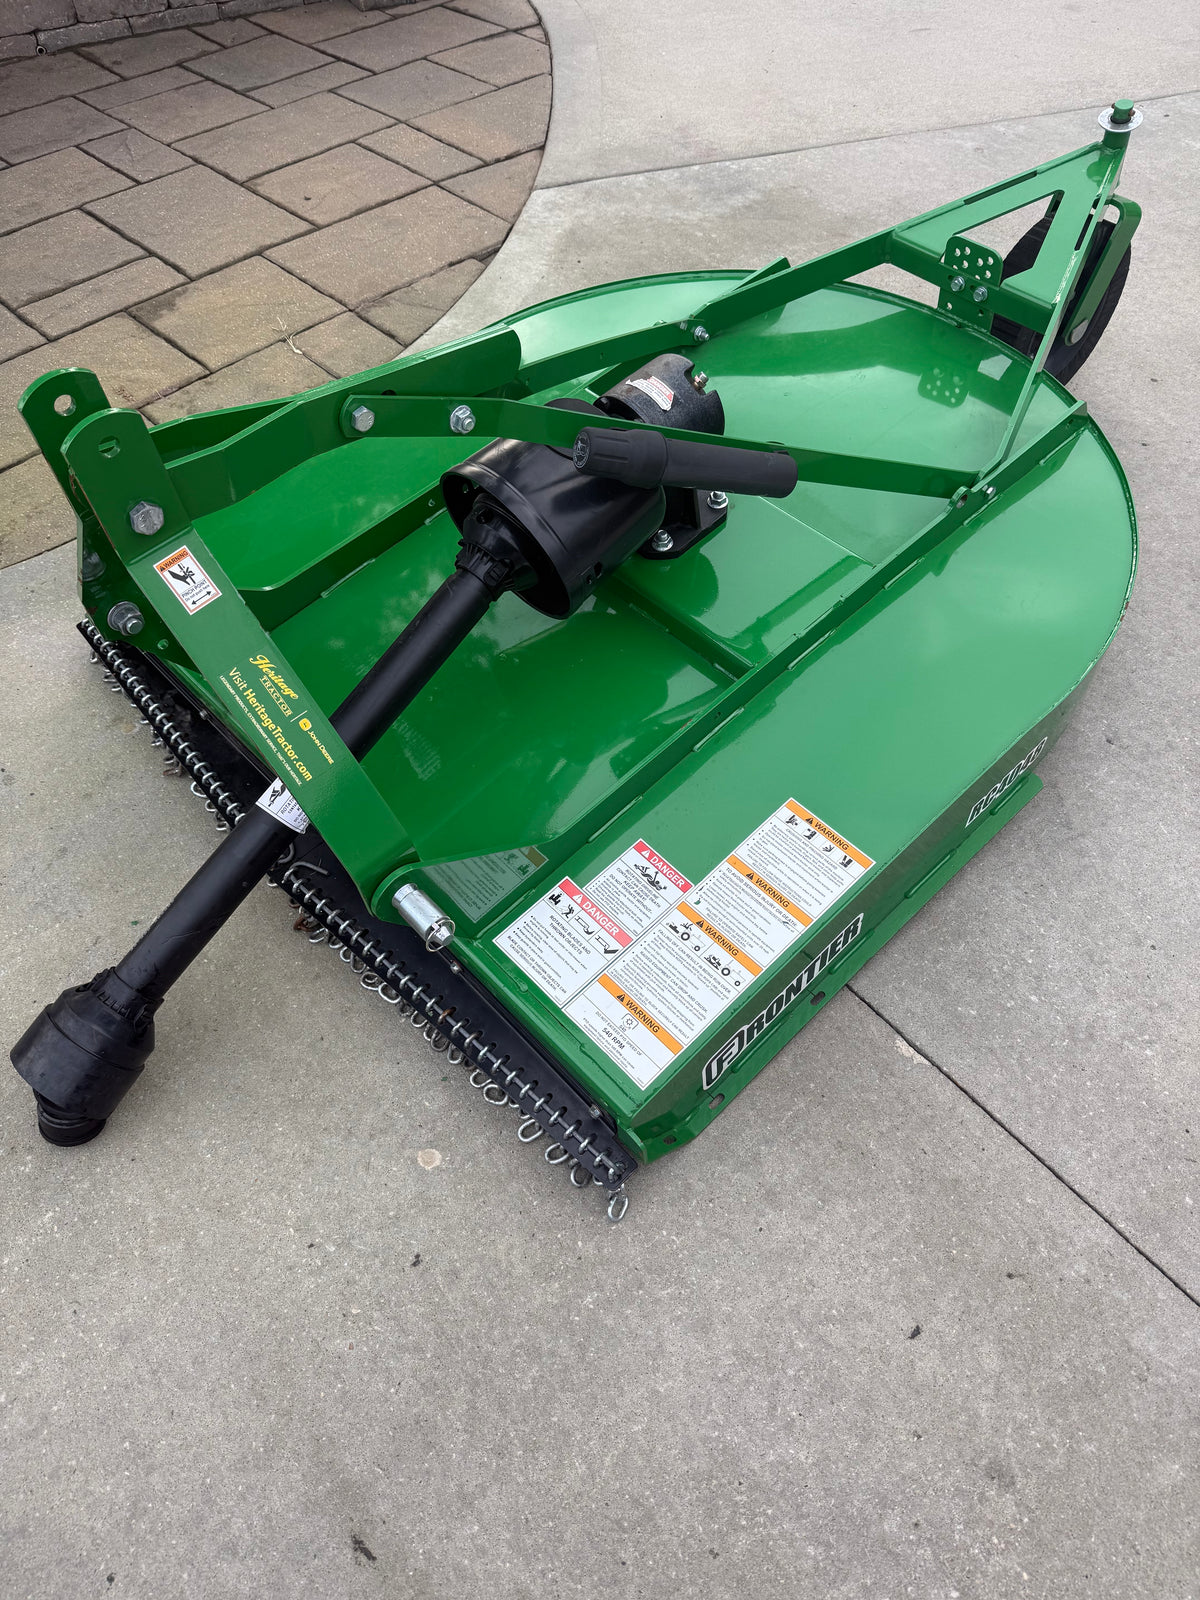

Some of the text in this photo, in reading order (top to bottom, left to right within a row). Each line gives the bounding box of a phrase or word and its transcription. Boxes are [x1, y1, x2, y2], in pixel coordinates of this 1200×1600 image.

[163, 550, 188, 568] WARNING
[181, 579, 206, 597] PINCH POINT
[249, 654, 298, 700] Heritage
[260, 675, 293, 717] TRACTOR
[229, 667, 313, 782] Visit HeritageTractor.com
[308, 730, 334, 765] JOHN DEERE
[813, 822, 849, 850] WARNING
[649, 855, 685, 887] DANGER
[730, 871, 744, 883] AVOID
[742, 881, 761, 897] SERIOUS
[760, 896, 776, 909] INJURY
[754, 877, 790, 908] WARNING
[548, 914, 568, 933] ROTATING
[566, 931, 583, 947] BLADES
[581, 944, 591, 954] AND
[582, 900, 619, 935] DANGER
[548, 922, 566, 939] THROWN
[564, 937, 583, 954] OBJECTS
[703, 925, 740, 956] WARNING
[625, 999, 660, 1033] WARNING
[702, 913, 863, 1091] FRONTIER
[601, 1027, 625, 1049] 540 RPM
